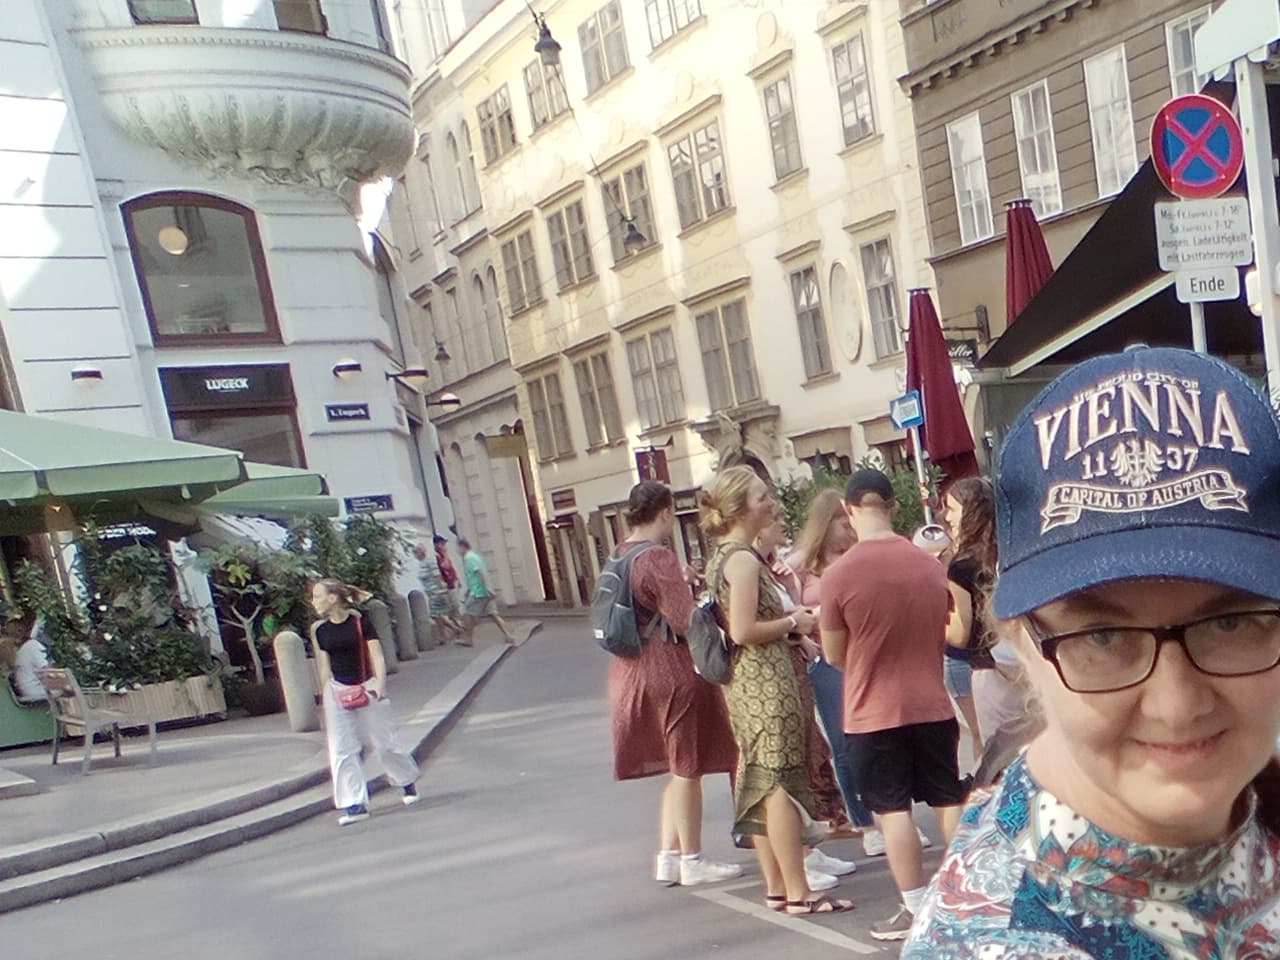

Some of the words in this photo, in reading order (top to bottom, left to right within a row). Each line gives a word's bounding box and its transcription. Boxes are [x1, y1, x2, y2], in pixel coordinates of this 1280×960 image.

[1190, 276, 1225, 294] Ende
[205, 378, 249, 390] LUGECK
[1034, 380, 1251, 471] VIENNA
[1081, 452, 1108, 480] 11
[1166, 446, 1199, 473] 37
[1060, 487, 1123, 508] CAPITAL
[1152, 474, 1219, 505] AUSTRIA
